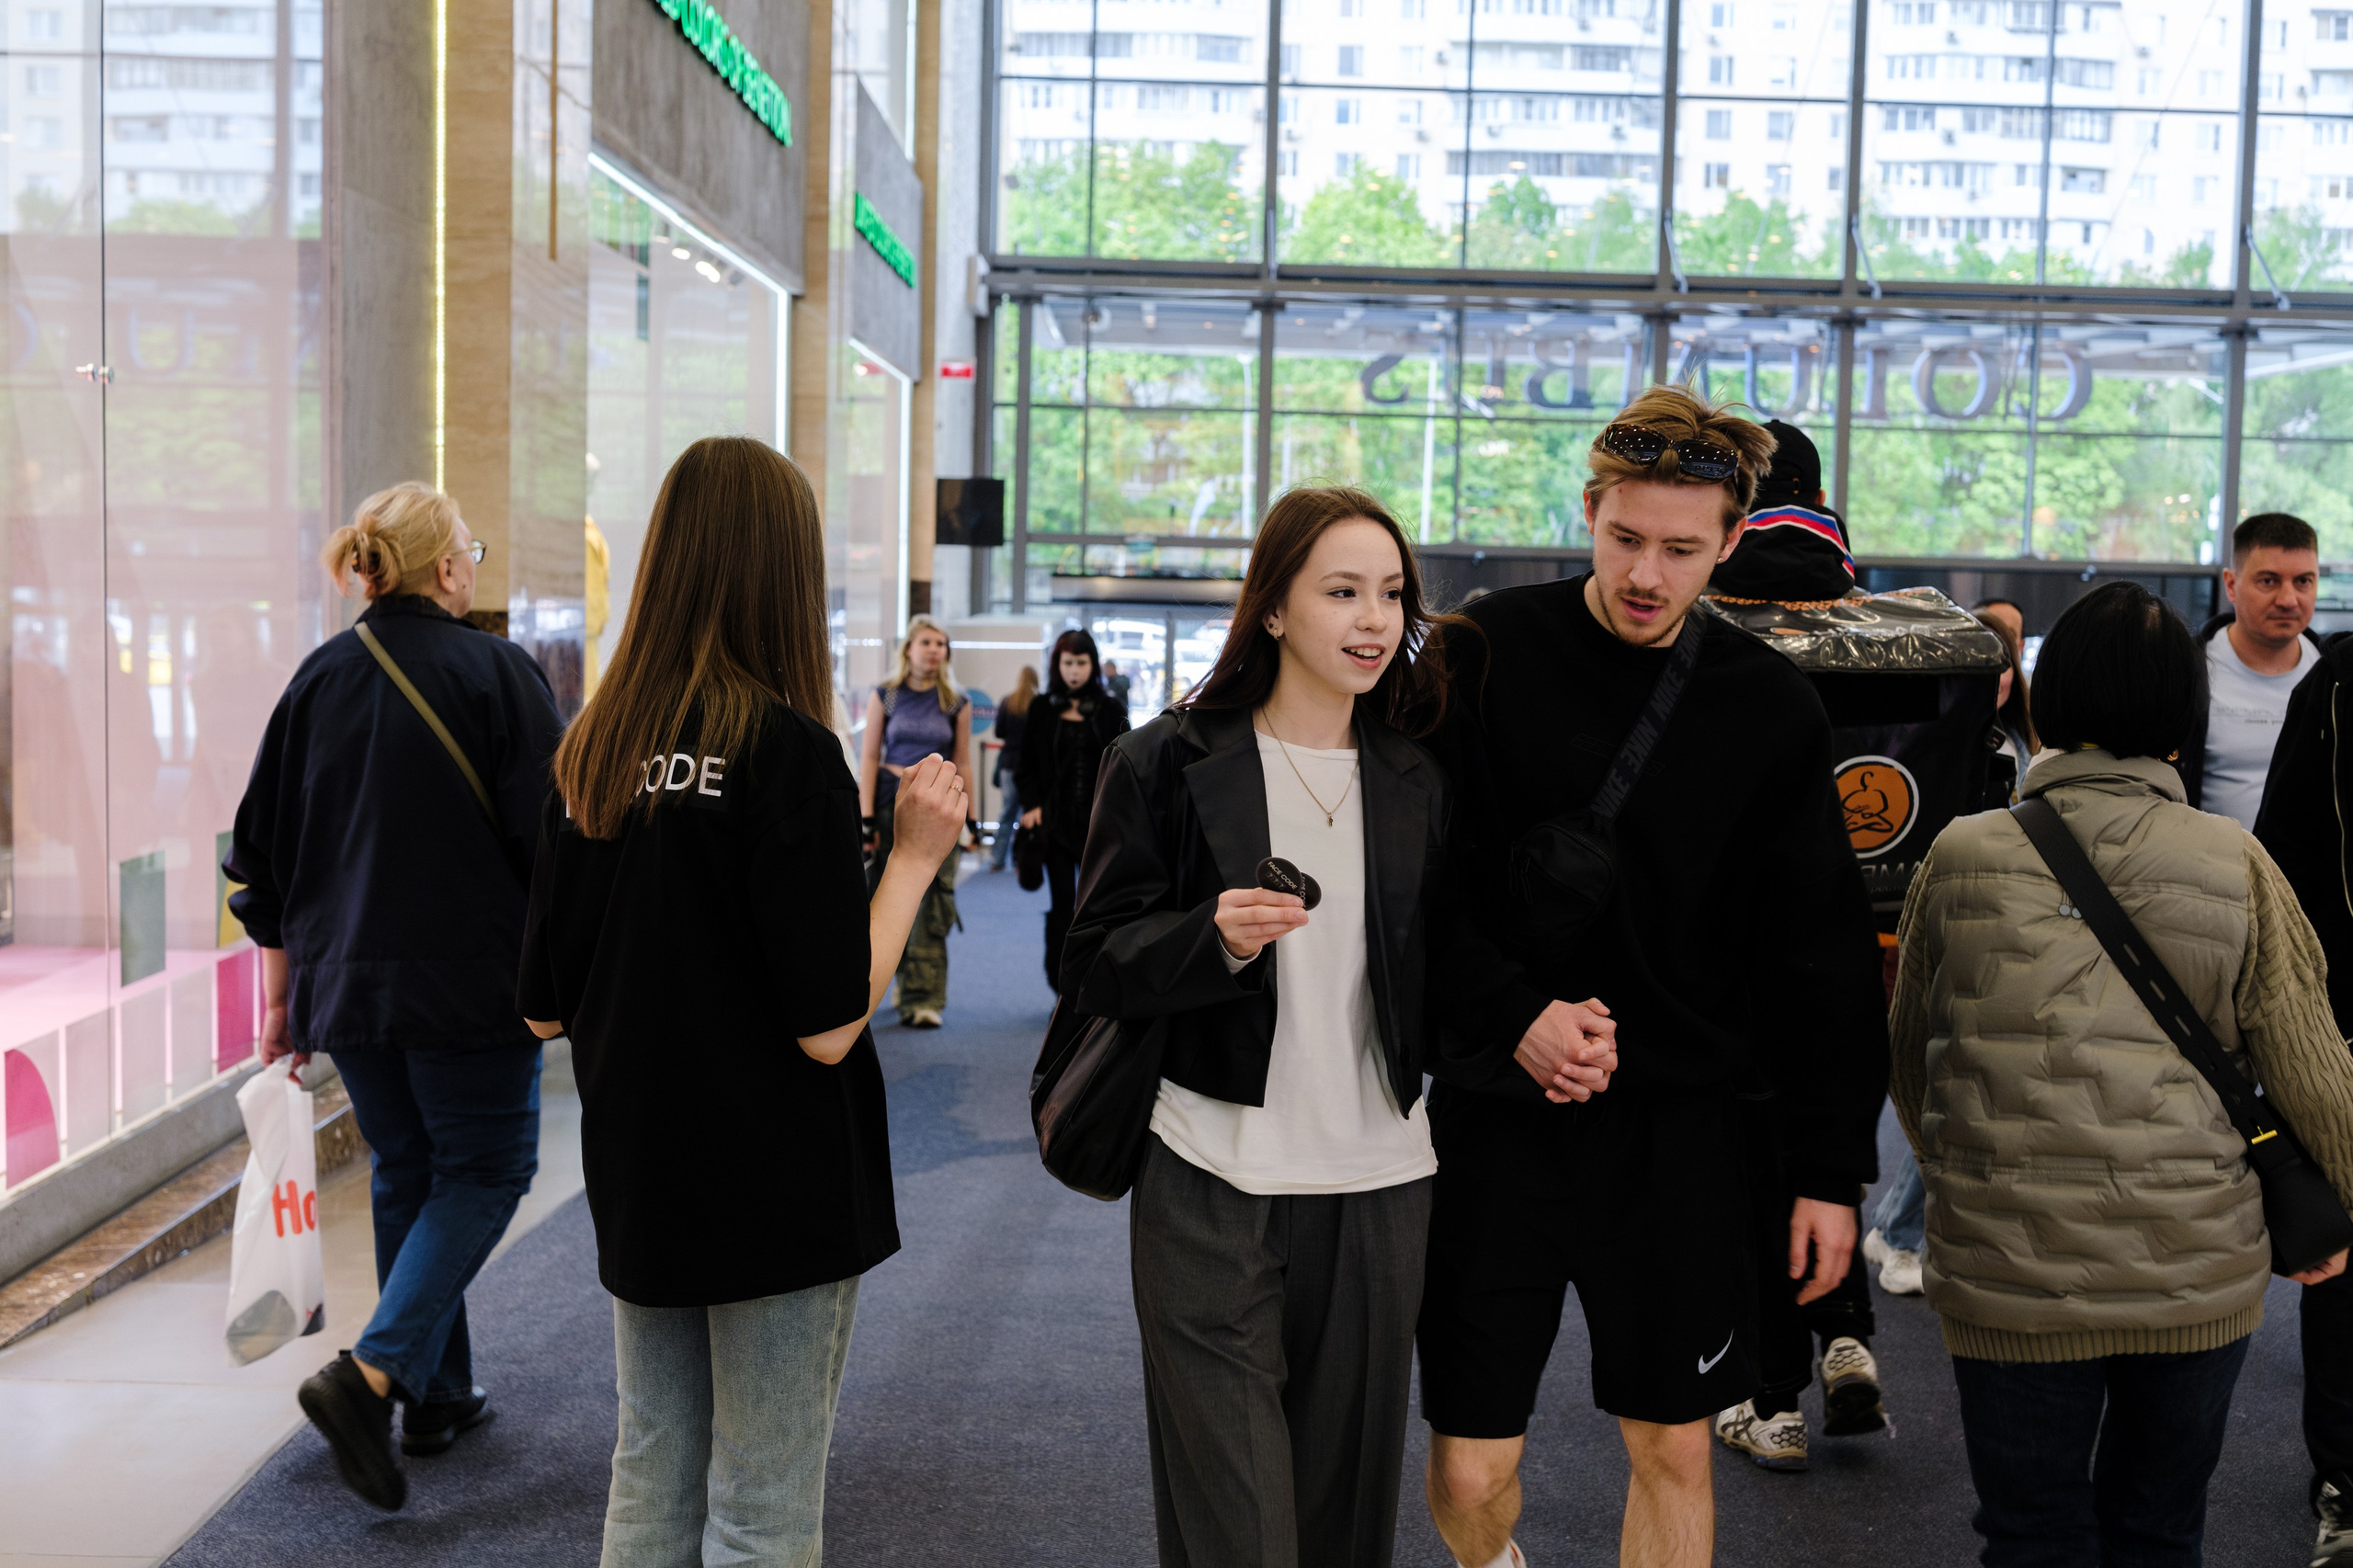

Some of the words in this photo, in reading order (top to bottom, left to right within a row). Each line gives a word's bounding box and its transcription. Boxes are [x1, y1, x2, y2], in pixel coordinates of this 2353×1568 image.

[1649, 663, 1686, 722] NIKE
[1619, 715, 1660, 775] NIKE
[1590, 767, 1631, 820] NIKE
[1267, 861, 1283, 876] FACE
[1280, 874, 1299, 890] CODE
